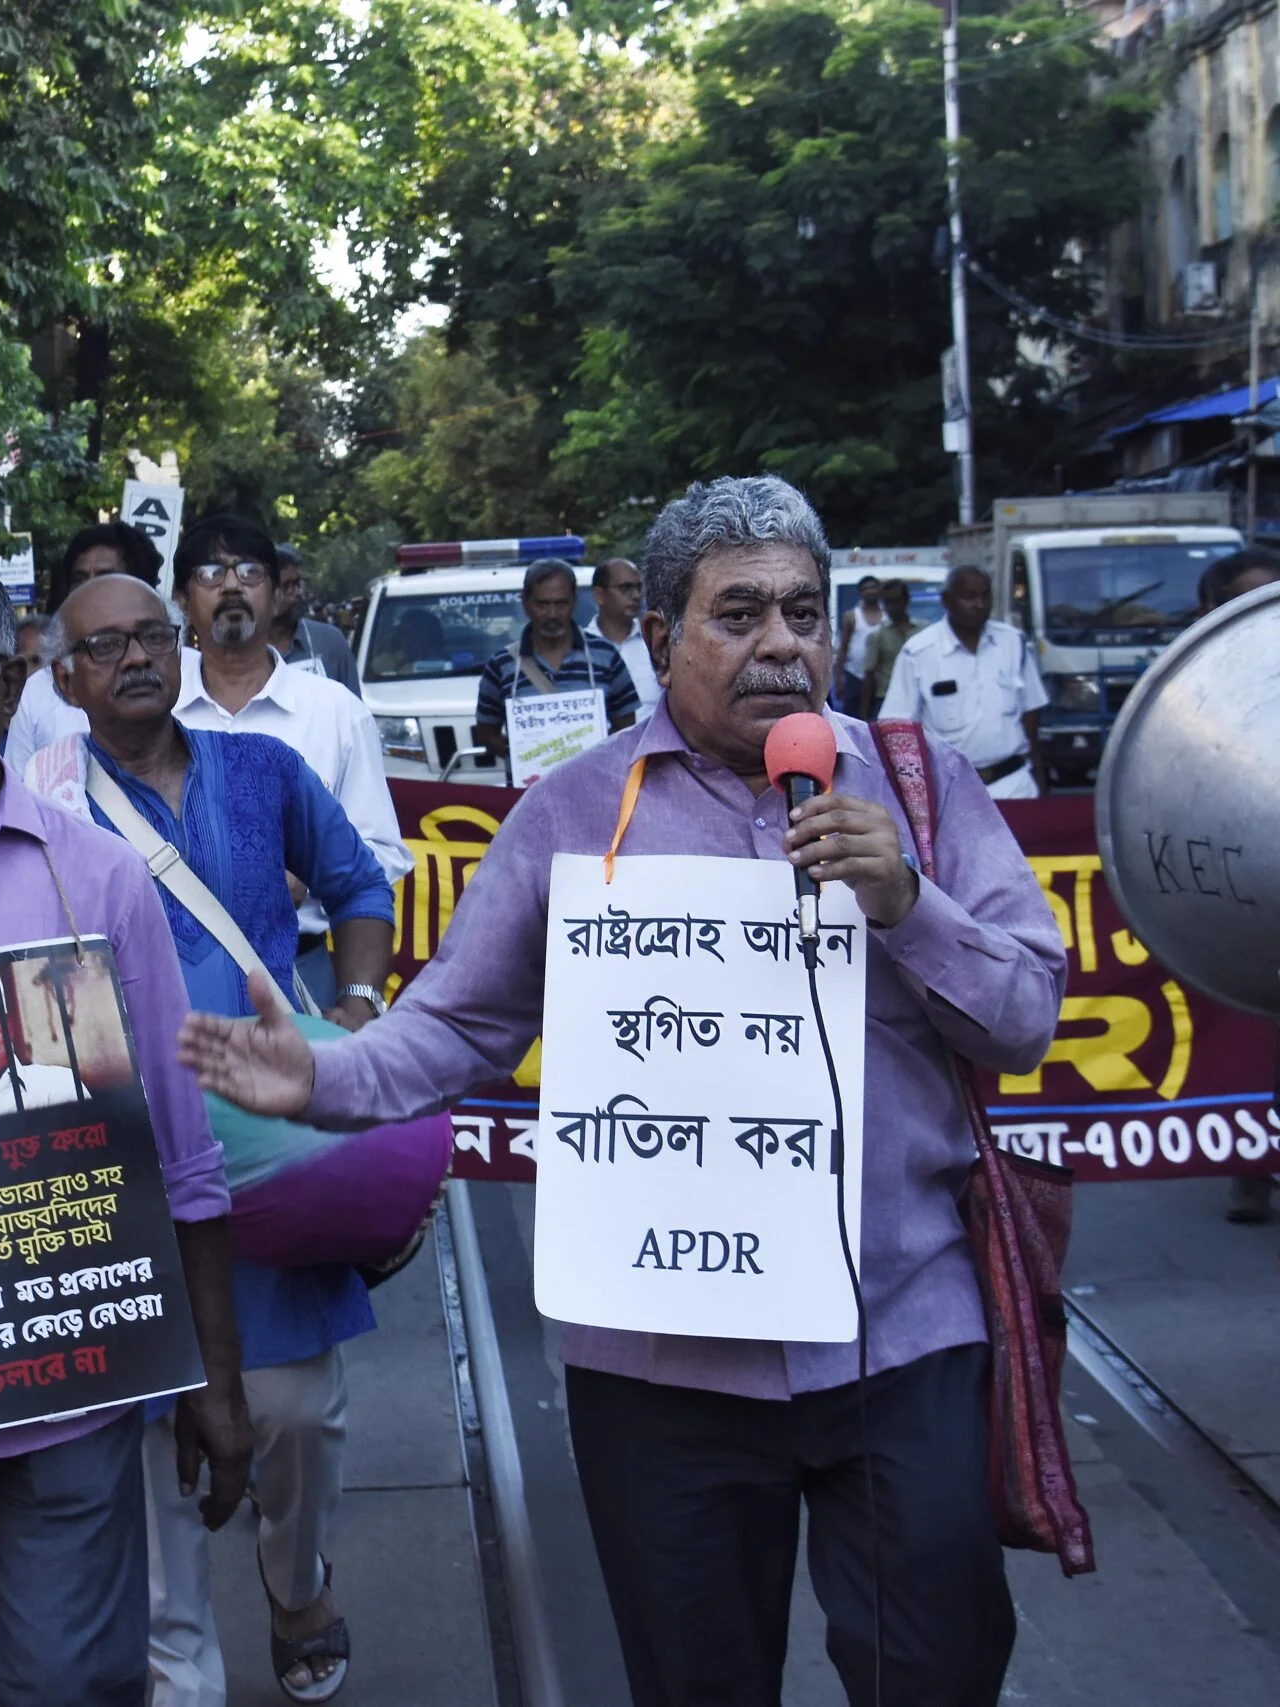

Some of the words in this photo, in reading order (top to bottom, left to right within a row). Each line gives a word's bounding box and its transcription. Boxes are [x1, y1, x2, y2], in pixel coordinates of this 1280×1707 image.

[439, 592, 504, 607] KOLKATA
[563, 904, 726, 963] রাষ্ট্রদ্রোহ
[606, 995, 724, 1062] স্থগিত
[740, 1012, 804, 1056] নয়
[0, 1135, 42, 1171] মুক্ত
[48, 1121, 108, 1151] করো
[551, 1094, 710, 1168] বাতিল
[47, 1172, 89, 1199] রাও
[91, 1165, 124, 1187] সহ
[15, 1228, 66, 1265] মুক্তি
[69, 1218, 112, 1247] চাই।
[632, 1227, 764, 1275] APDR
[14, 1276, 54, 1303] মত
[58, 1256, 154, 1297] প্রকাশের
[22, 1308, 84, 1342] কেড়ে
[89, 1293, 163, 1331] নেওয়া
[71, 1344, 108, 1375] না
